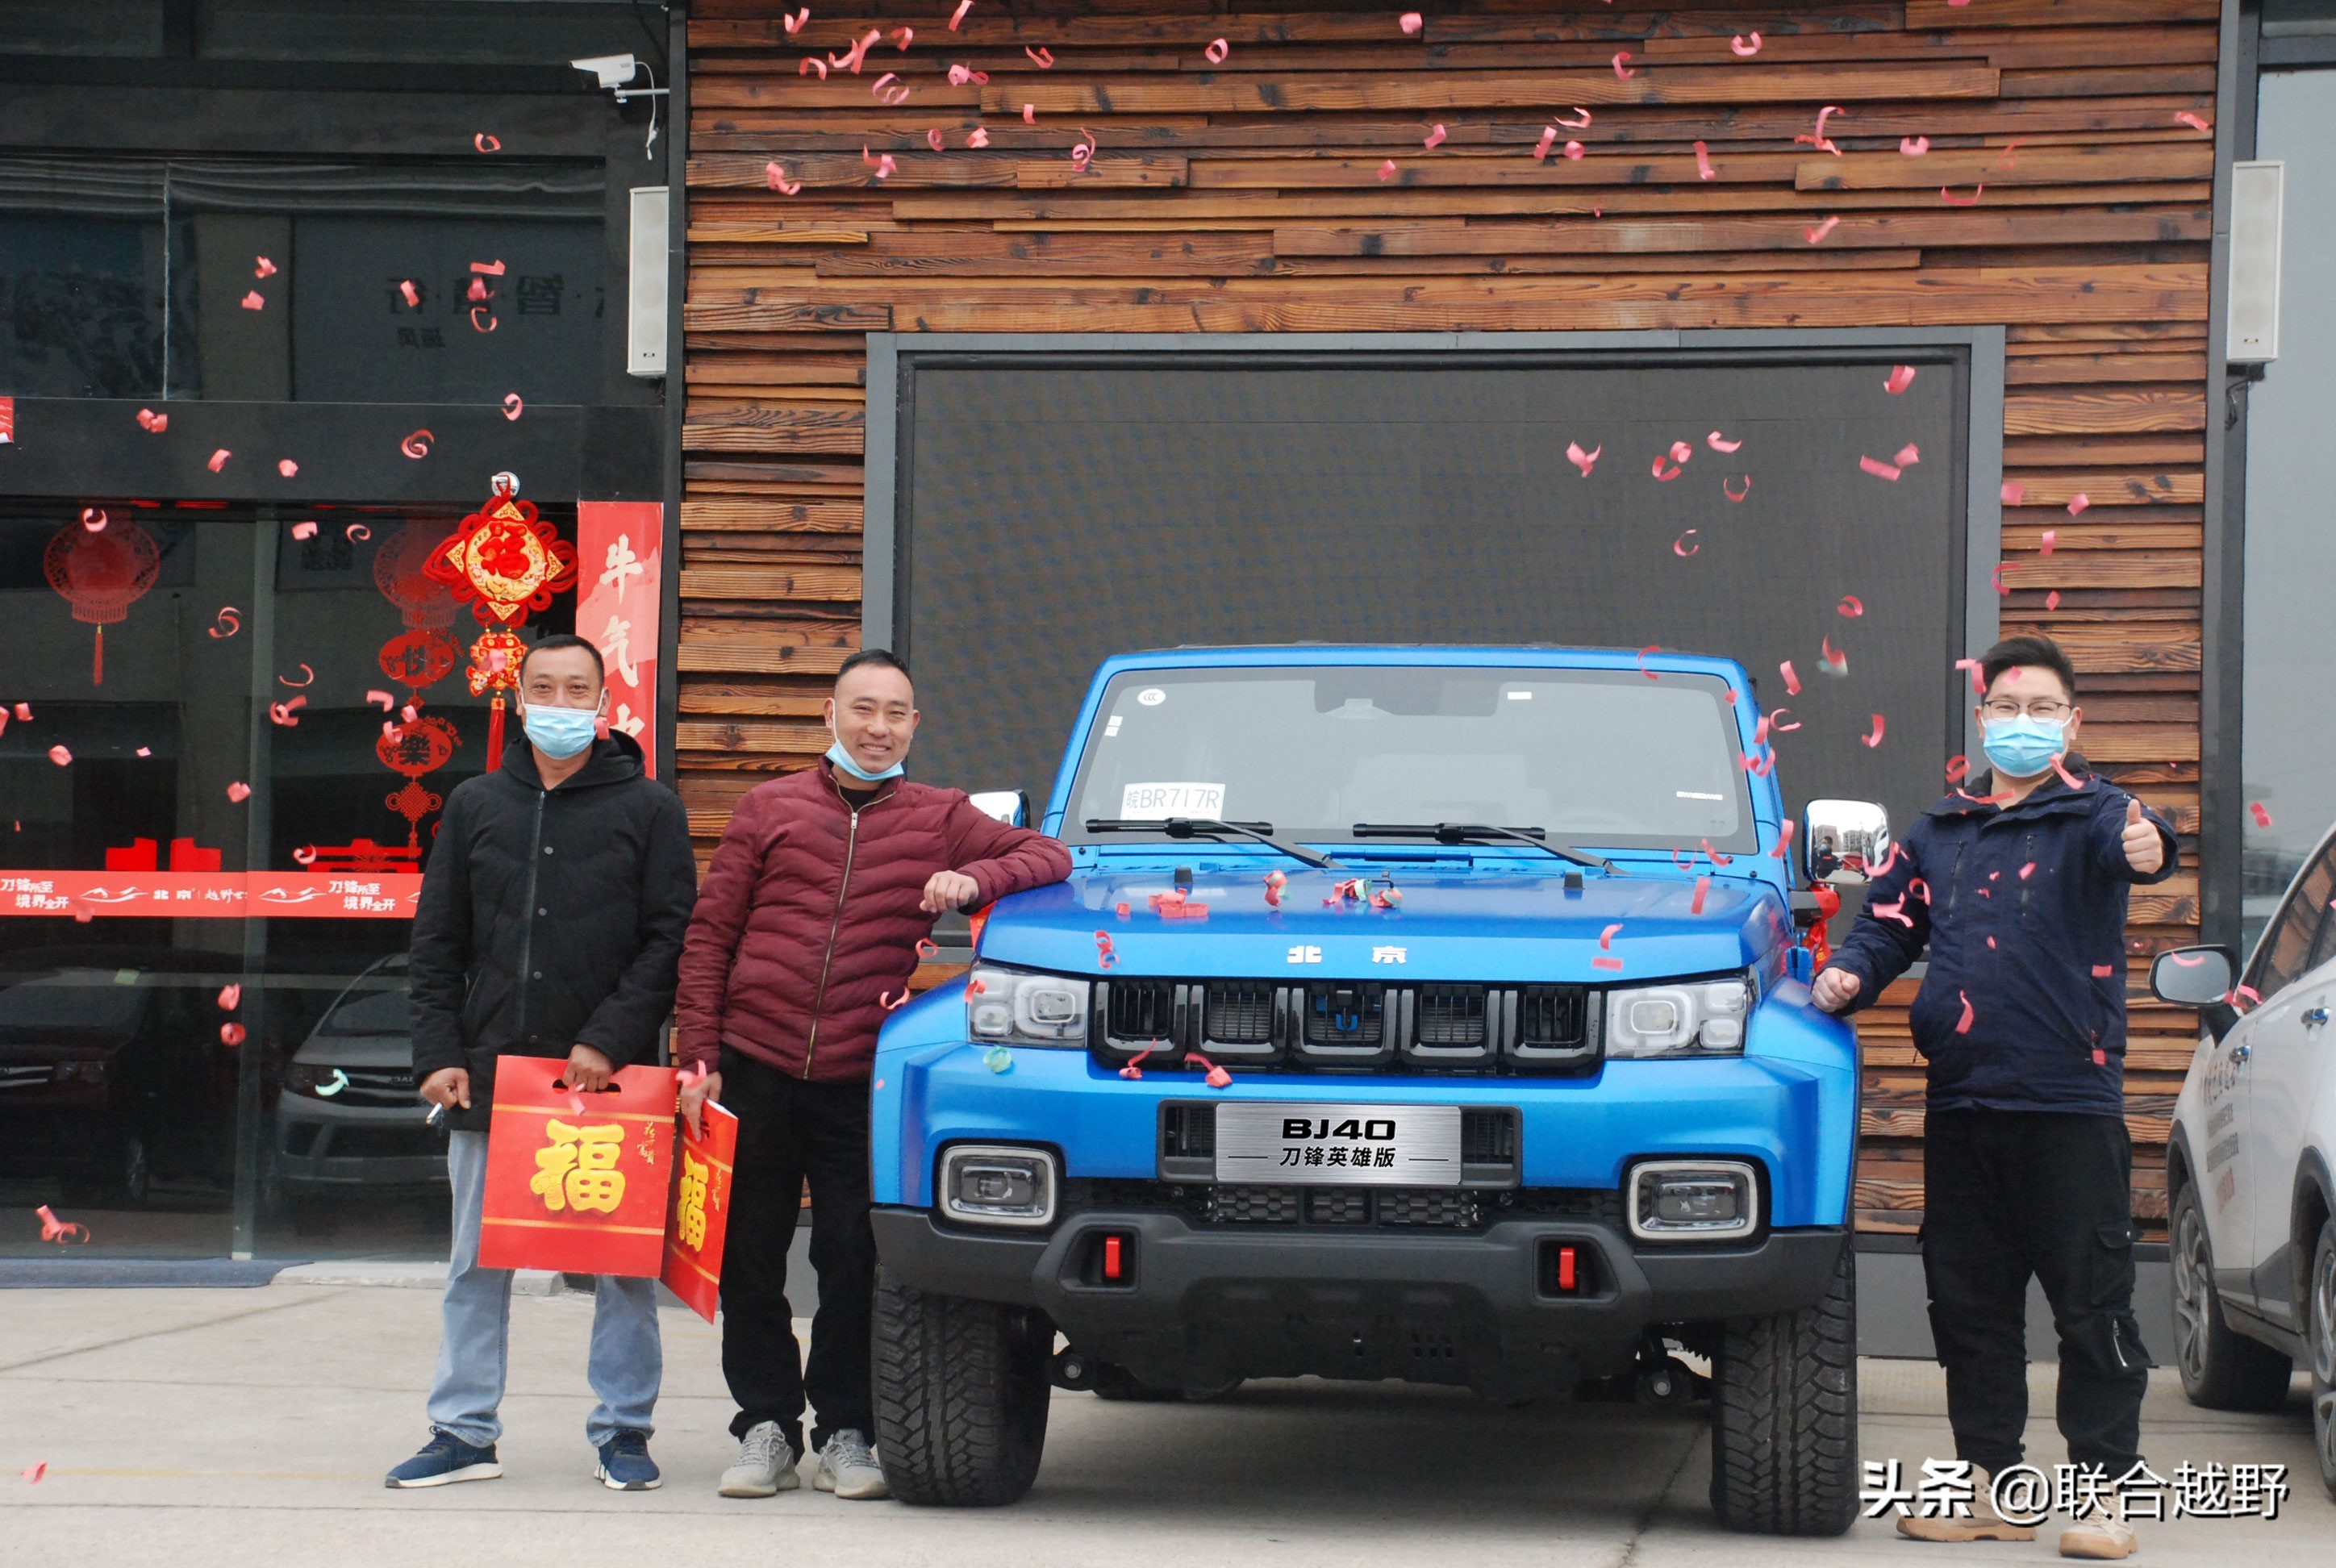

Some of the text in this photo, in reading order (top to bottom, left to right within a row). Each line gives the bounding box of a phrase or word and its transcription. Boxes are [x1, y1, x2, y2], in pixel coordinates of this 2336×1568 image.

[478, 521, 531, 579] 福
[15, 894, 69, 909] 境界全开
[343, 896, 395, 911] 境界全开
[1282, 1119, 1396, 1140] BJ40
[530, 1119, 626, 1213] 福
[1279, 1146, 1396, 1168] 刀锋英雄版
[677, 1149, 709, 1252] 福
